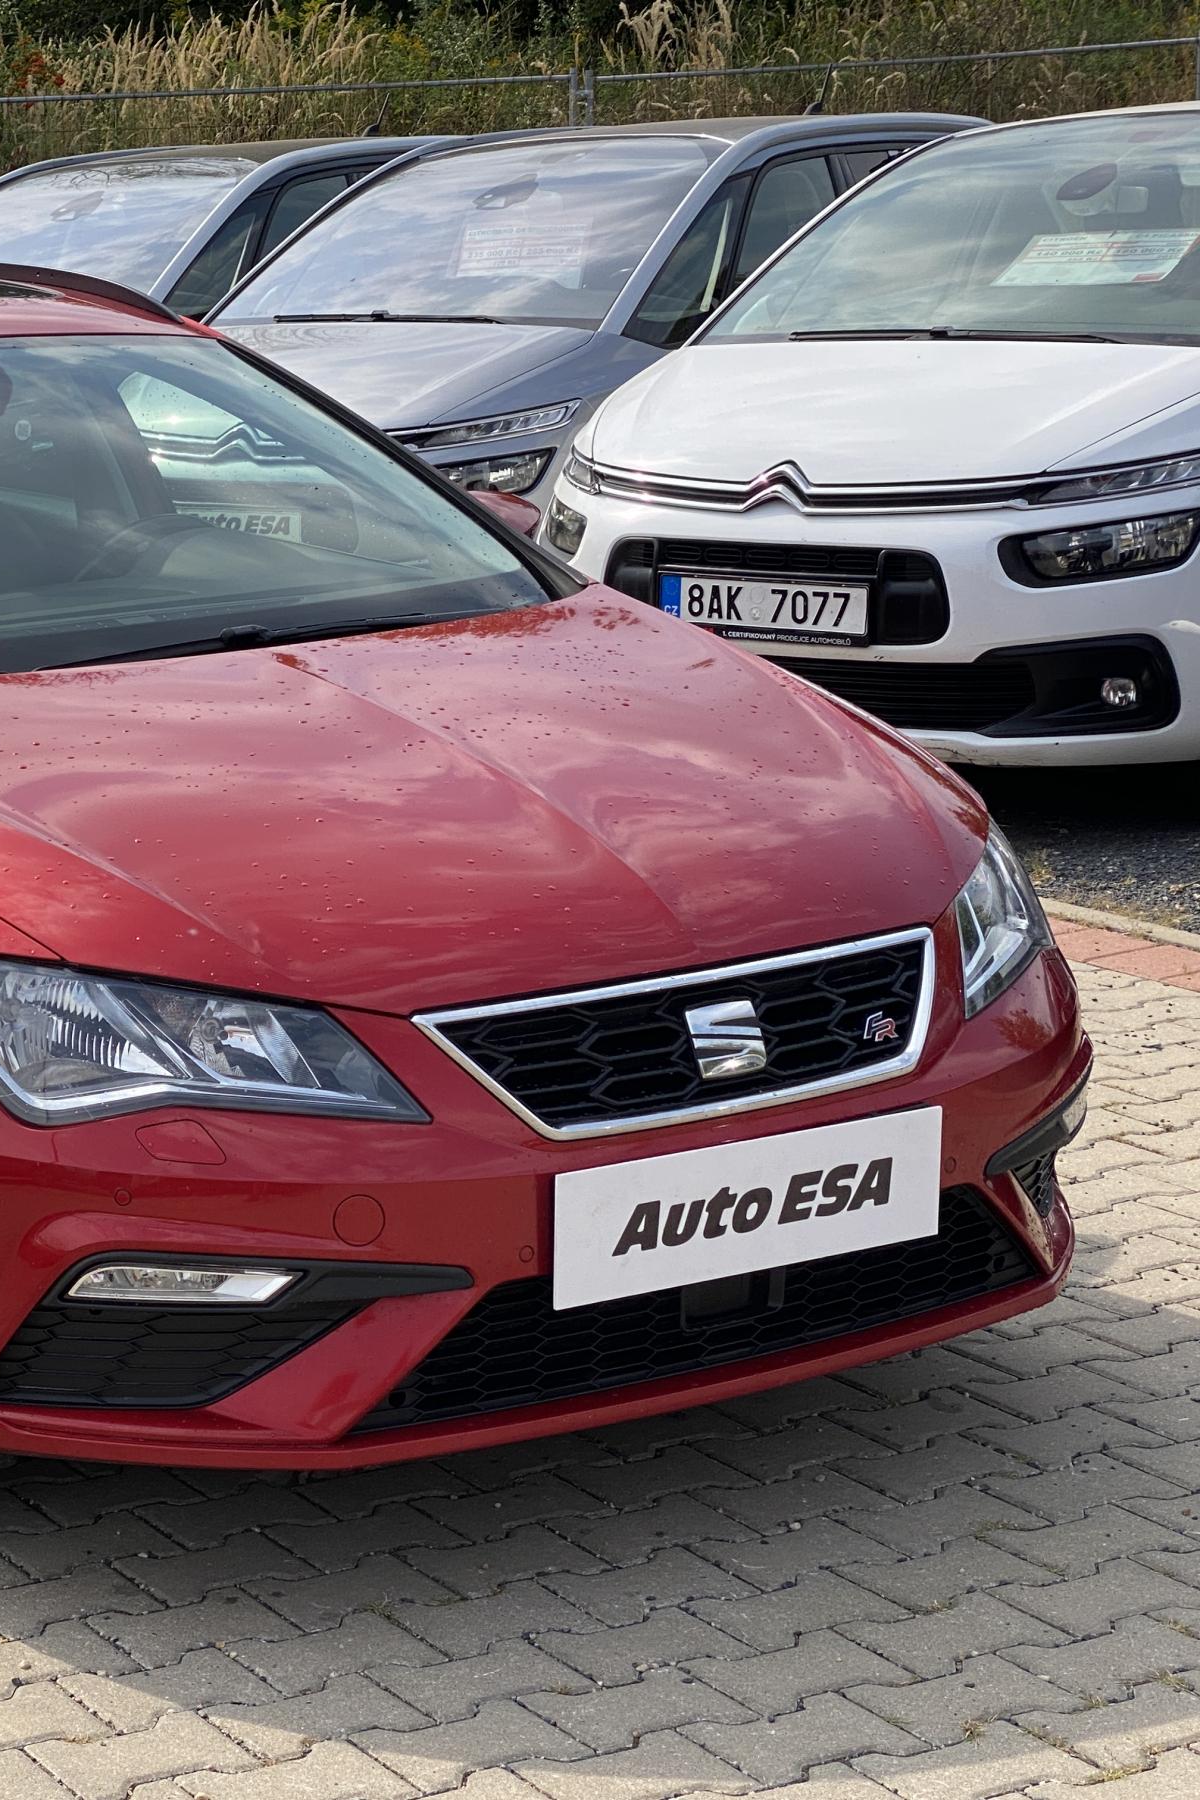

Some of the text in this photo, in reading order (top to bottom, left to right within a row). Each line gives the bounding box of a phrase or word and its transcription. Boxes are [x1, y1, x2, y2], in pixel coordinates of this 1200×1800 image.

[244, 515, 290, 536] ESA
[664, 604, 679, 616] CZ
[687, 583, 851, 627] 8AK 7077
[728, 630, 776, 641] CERTIFIKOVANÝ
[776, 634, 809, 643] PRODEJCE
[863, 1011, 899, 1042] FR
[777, 1156, 894, 1225] ESA
